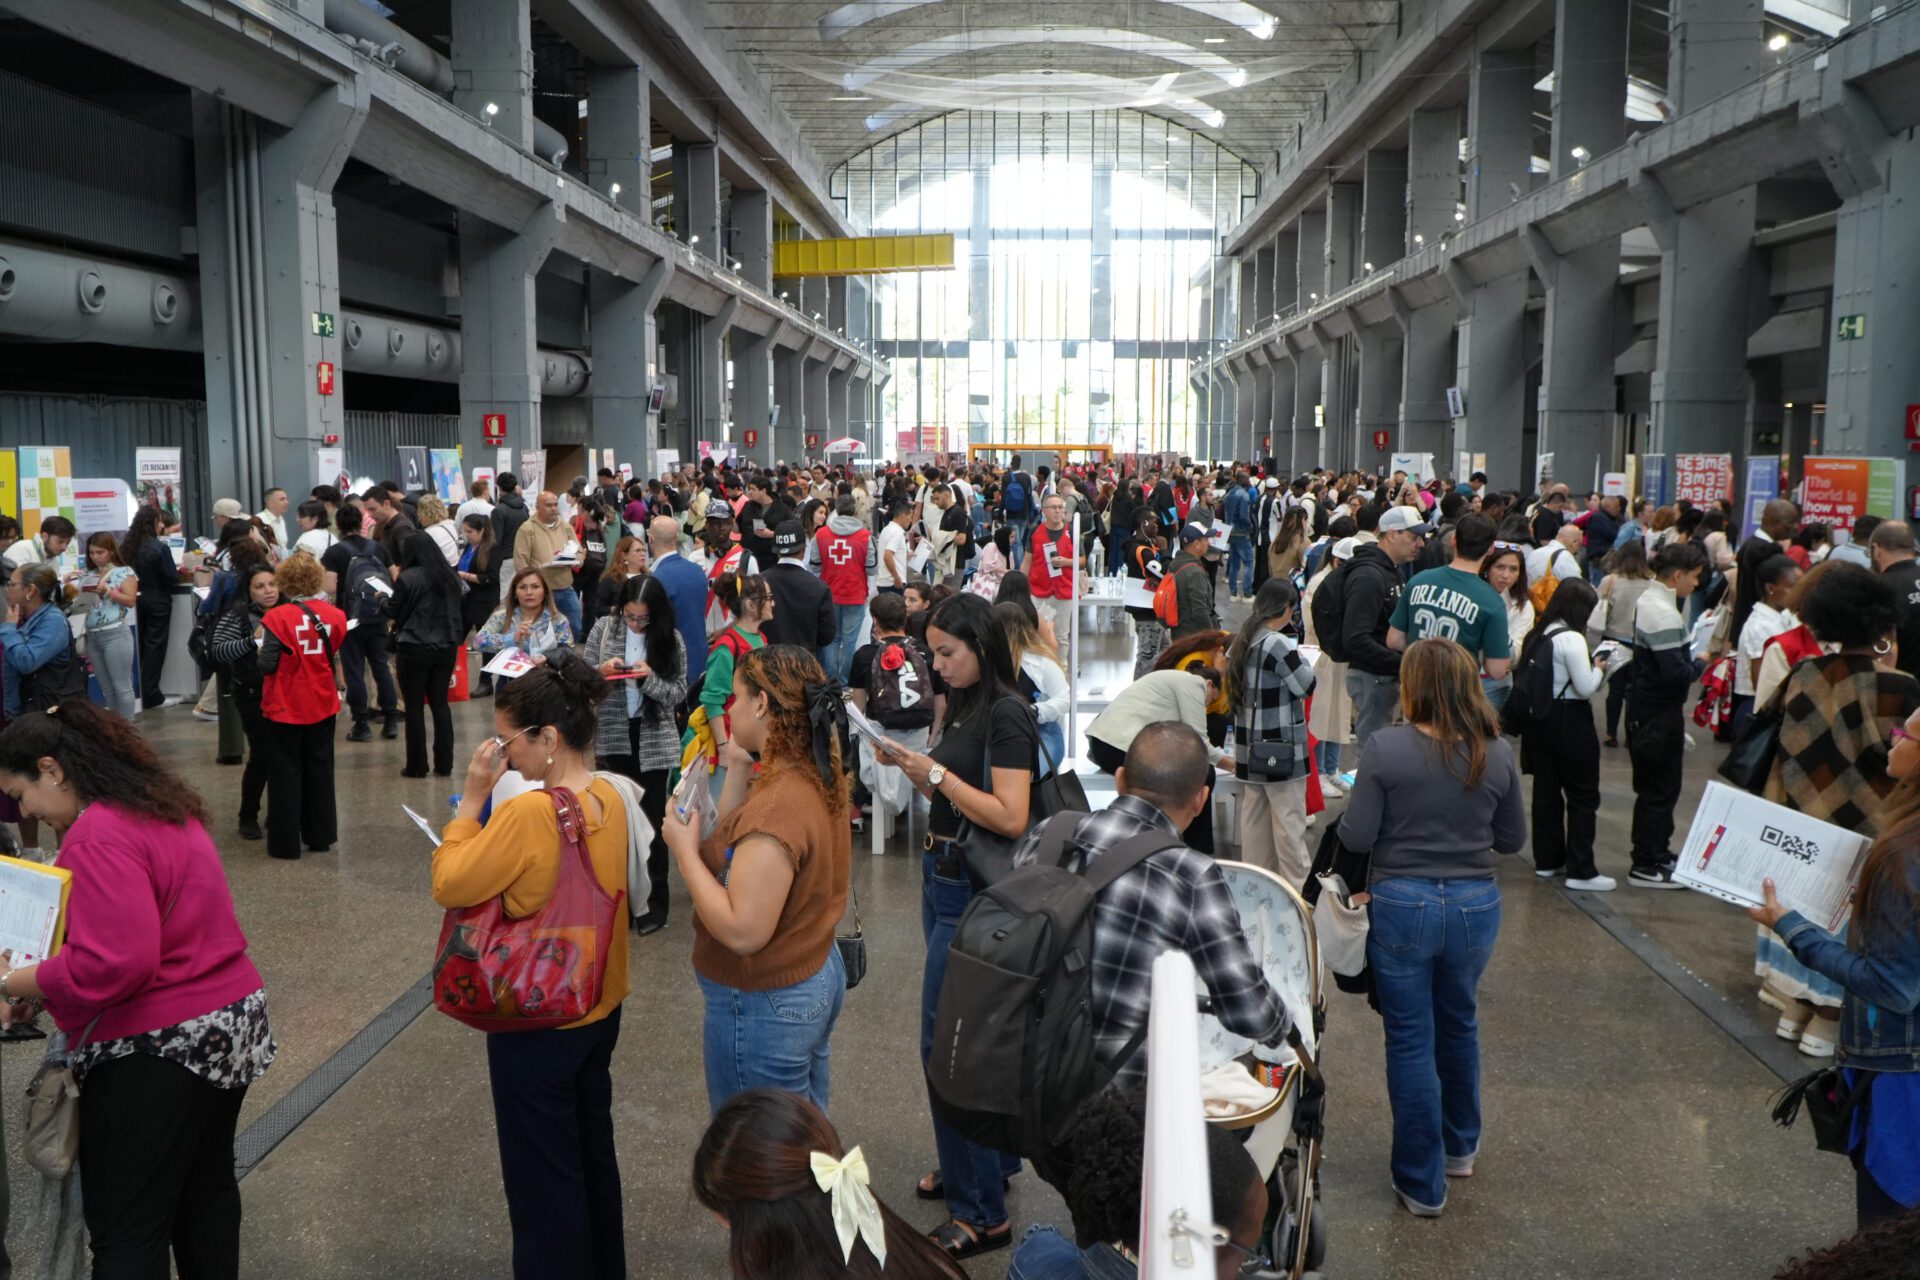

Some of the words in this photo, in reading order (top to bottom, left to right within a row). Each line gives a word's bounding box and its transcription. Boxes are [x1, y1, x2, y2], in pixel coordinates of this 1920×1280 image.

[1809, 476, 1831, 488] The
[1808, 490, 1842, 502] world
[1847, 490, 1857, 502] is
[1806, 501, 1832, 513] how
[1836, 505, 1853, 514] we
[1801, 513, 1843, 527] shape
[775, 533, 796, 544] ICON
[586, 540, 606, 553] VANS
[1410, 584, 1479, 625] ORLANDO
